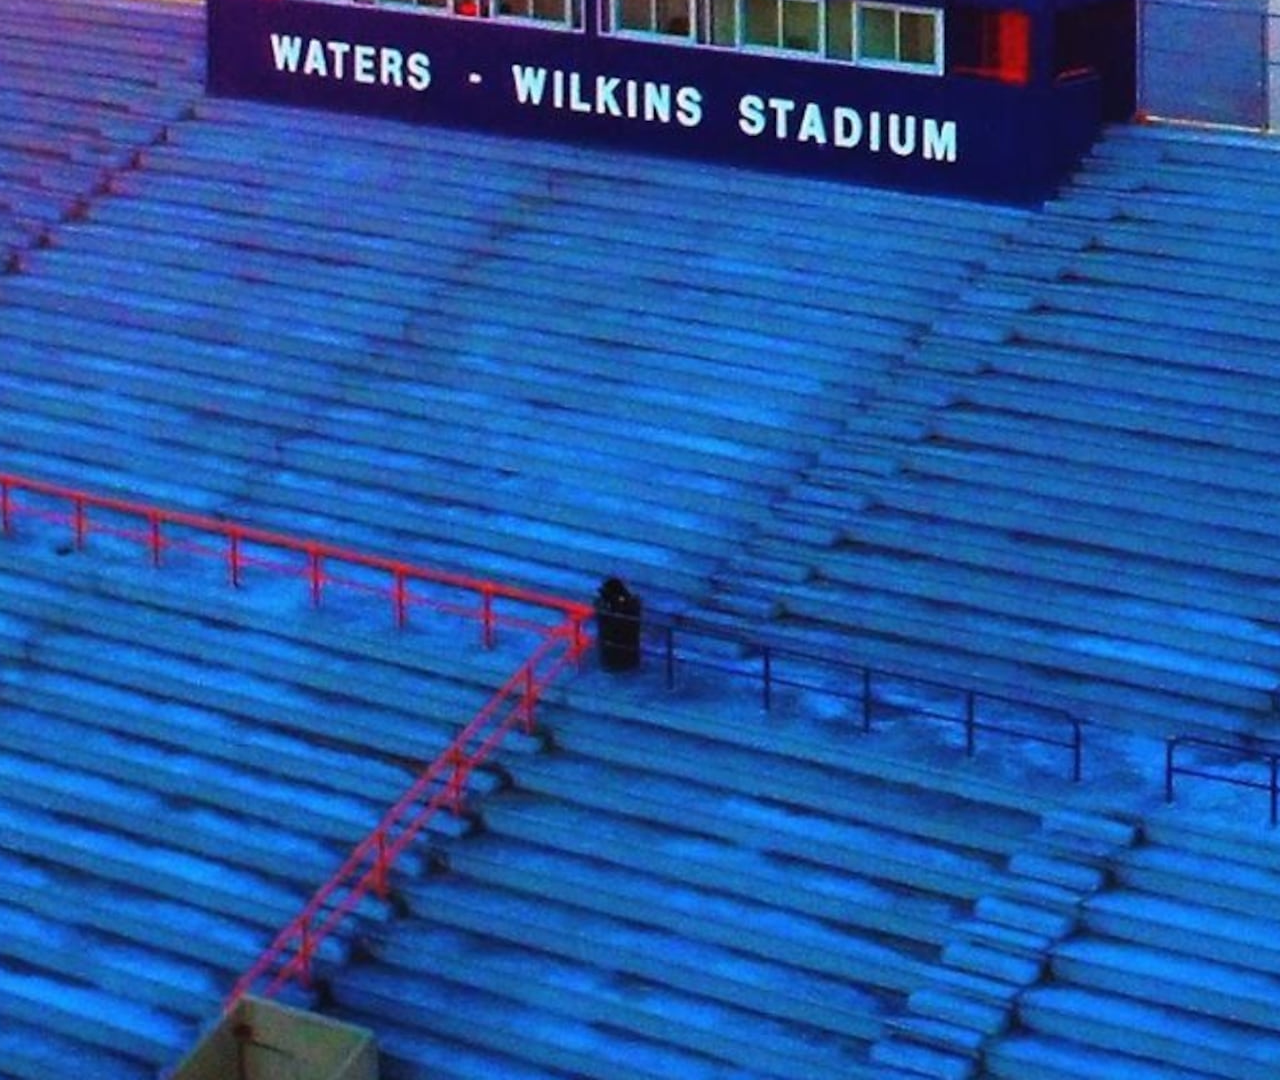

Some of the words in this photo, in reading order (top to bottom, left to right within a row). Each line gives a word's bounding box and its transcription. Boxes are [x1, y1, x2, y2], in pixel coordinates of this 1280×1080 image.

[270, 33, 431, 91] WATERS
[511, 64, 702, 127] WILKINS
[738, 94, 957, 163] STADIUM
